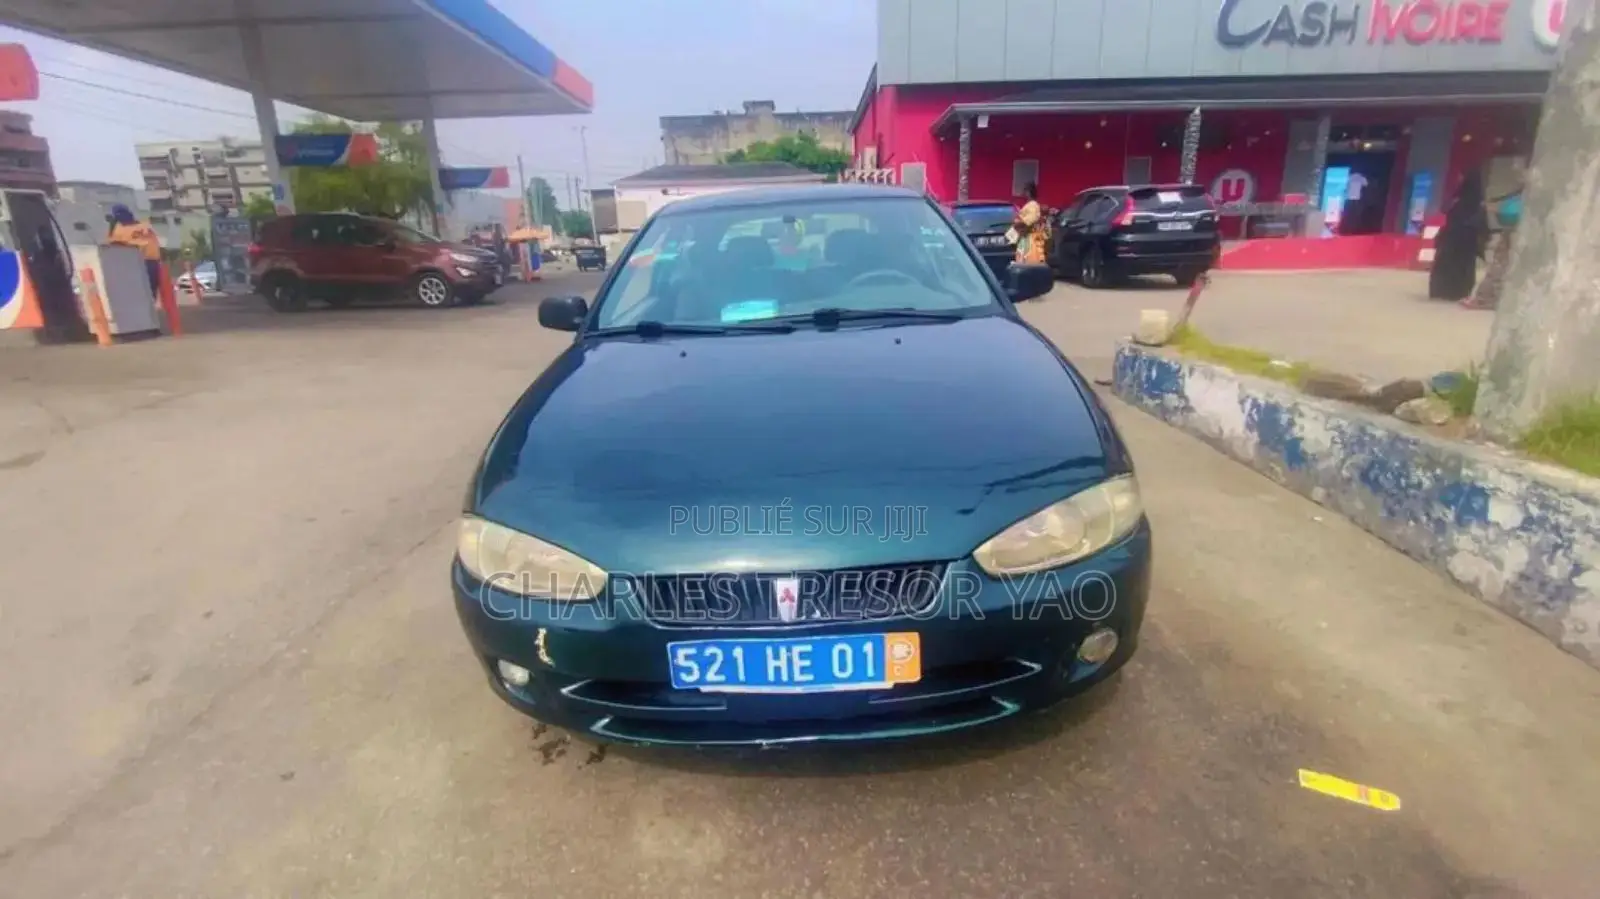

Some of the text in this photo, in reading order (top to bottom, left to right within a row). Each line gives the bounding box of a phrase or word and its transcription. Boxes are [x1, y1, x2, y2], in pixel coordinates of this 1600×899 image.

[1217, 0, 1360, 47] CASH
[1367, 0, 1510, 43] IVOIRE
[1222, 177, 1245, 203] U
[676, 641, 875, 683] 521 HE 01
